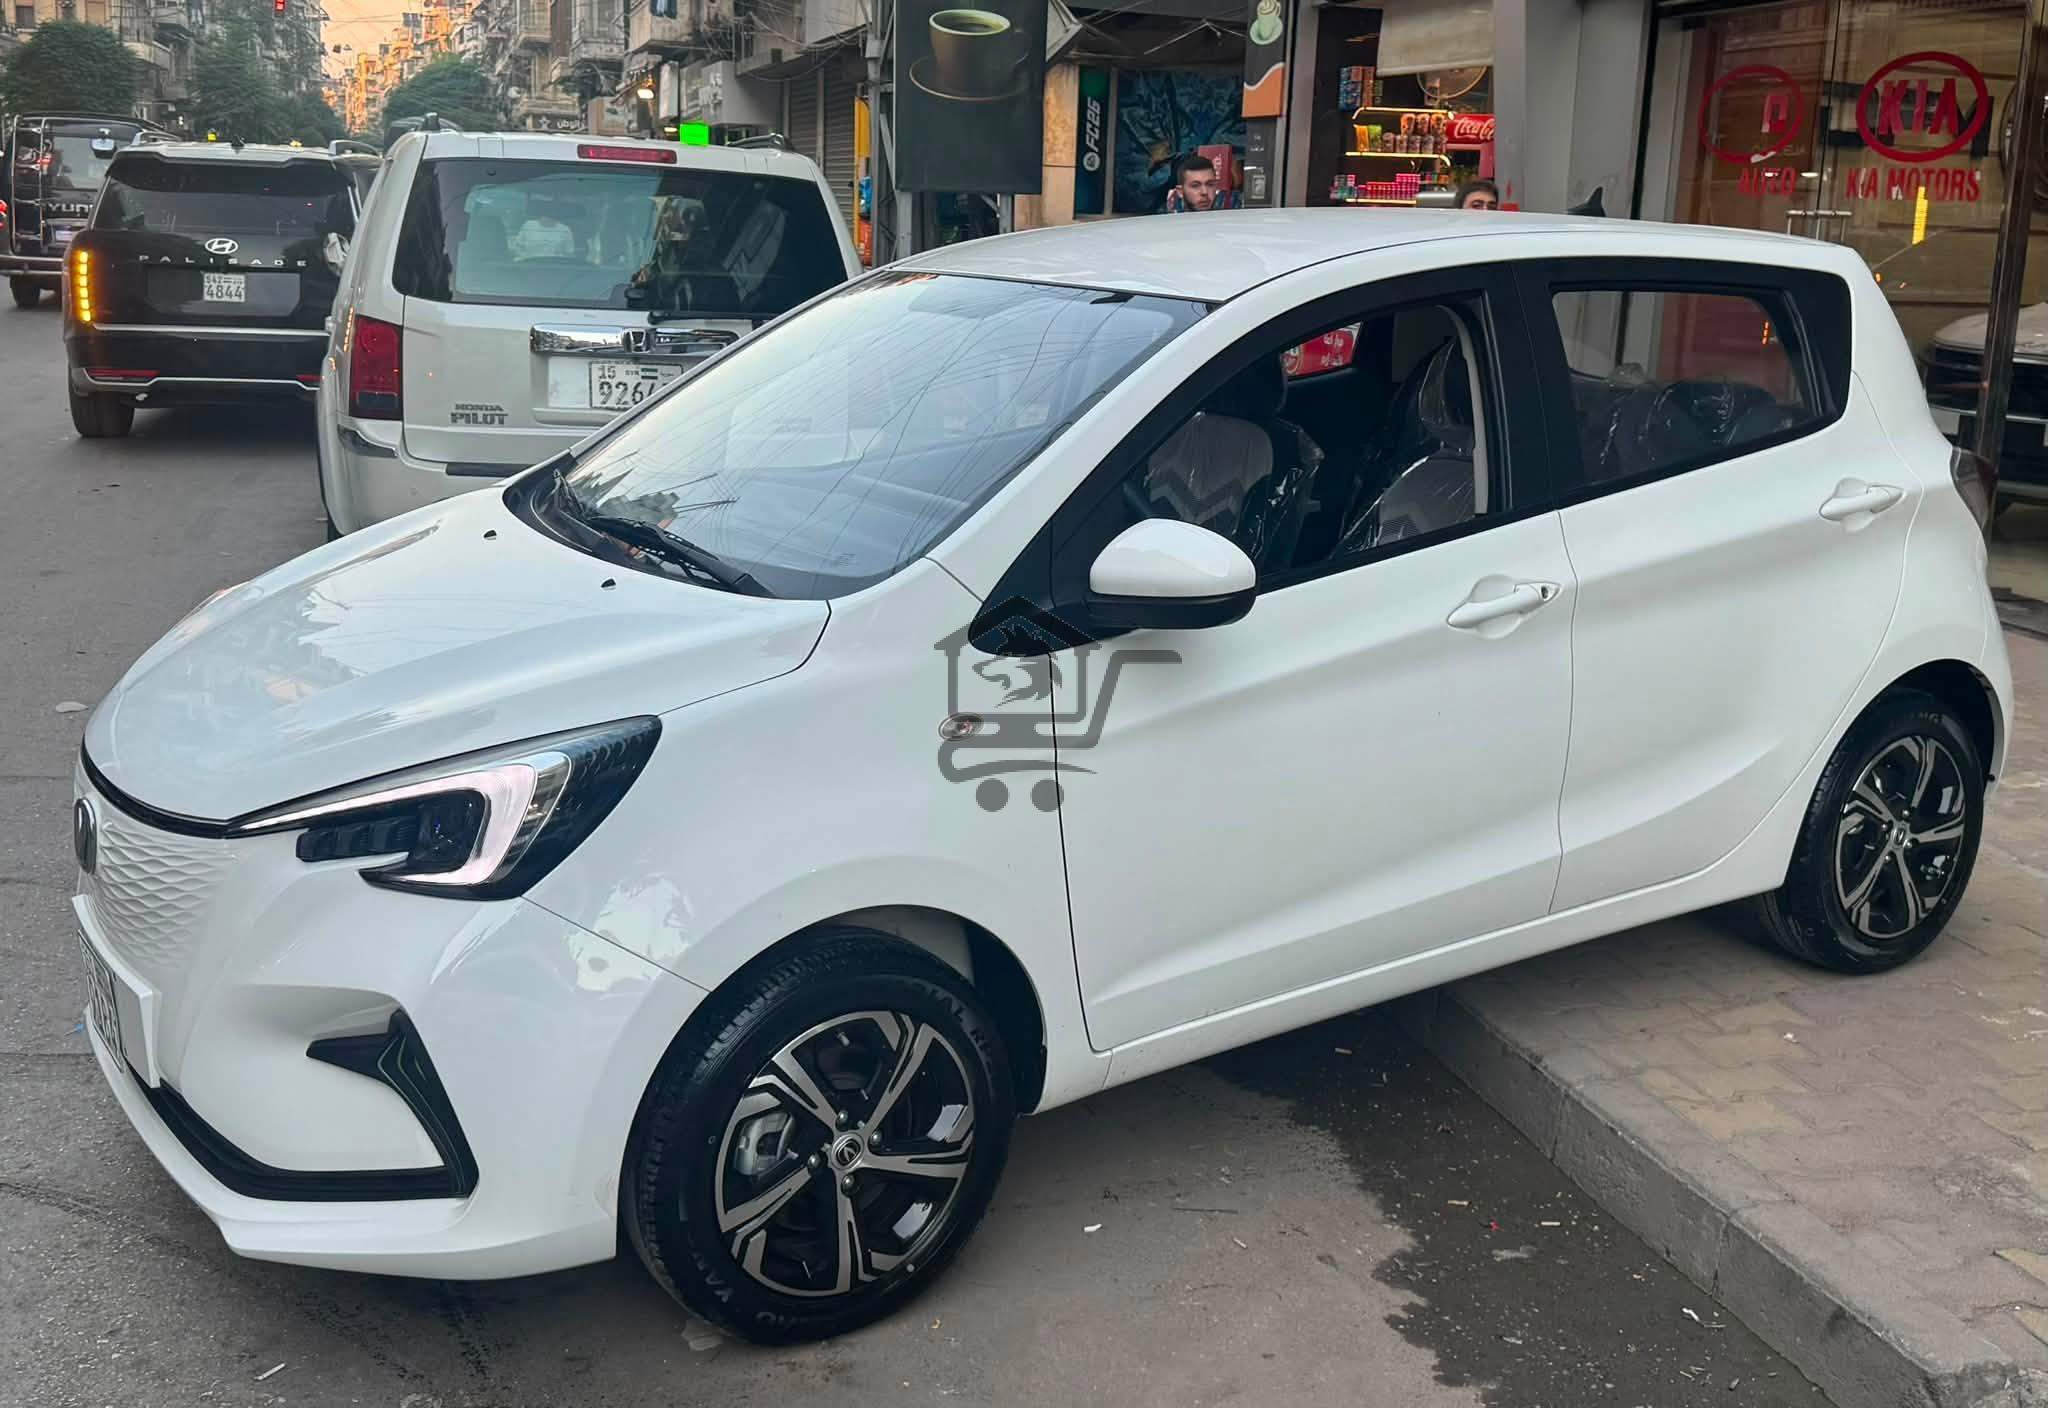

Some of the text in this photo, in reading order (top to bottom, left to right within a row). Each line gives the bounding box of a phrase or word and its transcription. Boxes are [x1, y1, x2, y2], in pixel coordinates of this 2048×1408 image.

[1877, 79, 1958, 136] KIA
[1846, 167, 1981, 202] KIA MOTORS
[48, 203, 89, 212] YUN
[139, 255, 307, 267] PALISADE
[207, 284, 242, 300] 4844
[598, 365, 616, 380] 15
[599, 381, 668, 405] 926
[451, 412, 508, 425] PILOT
